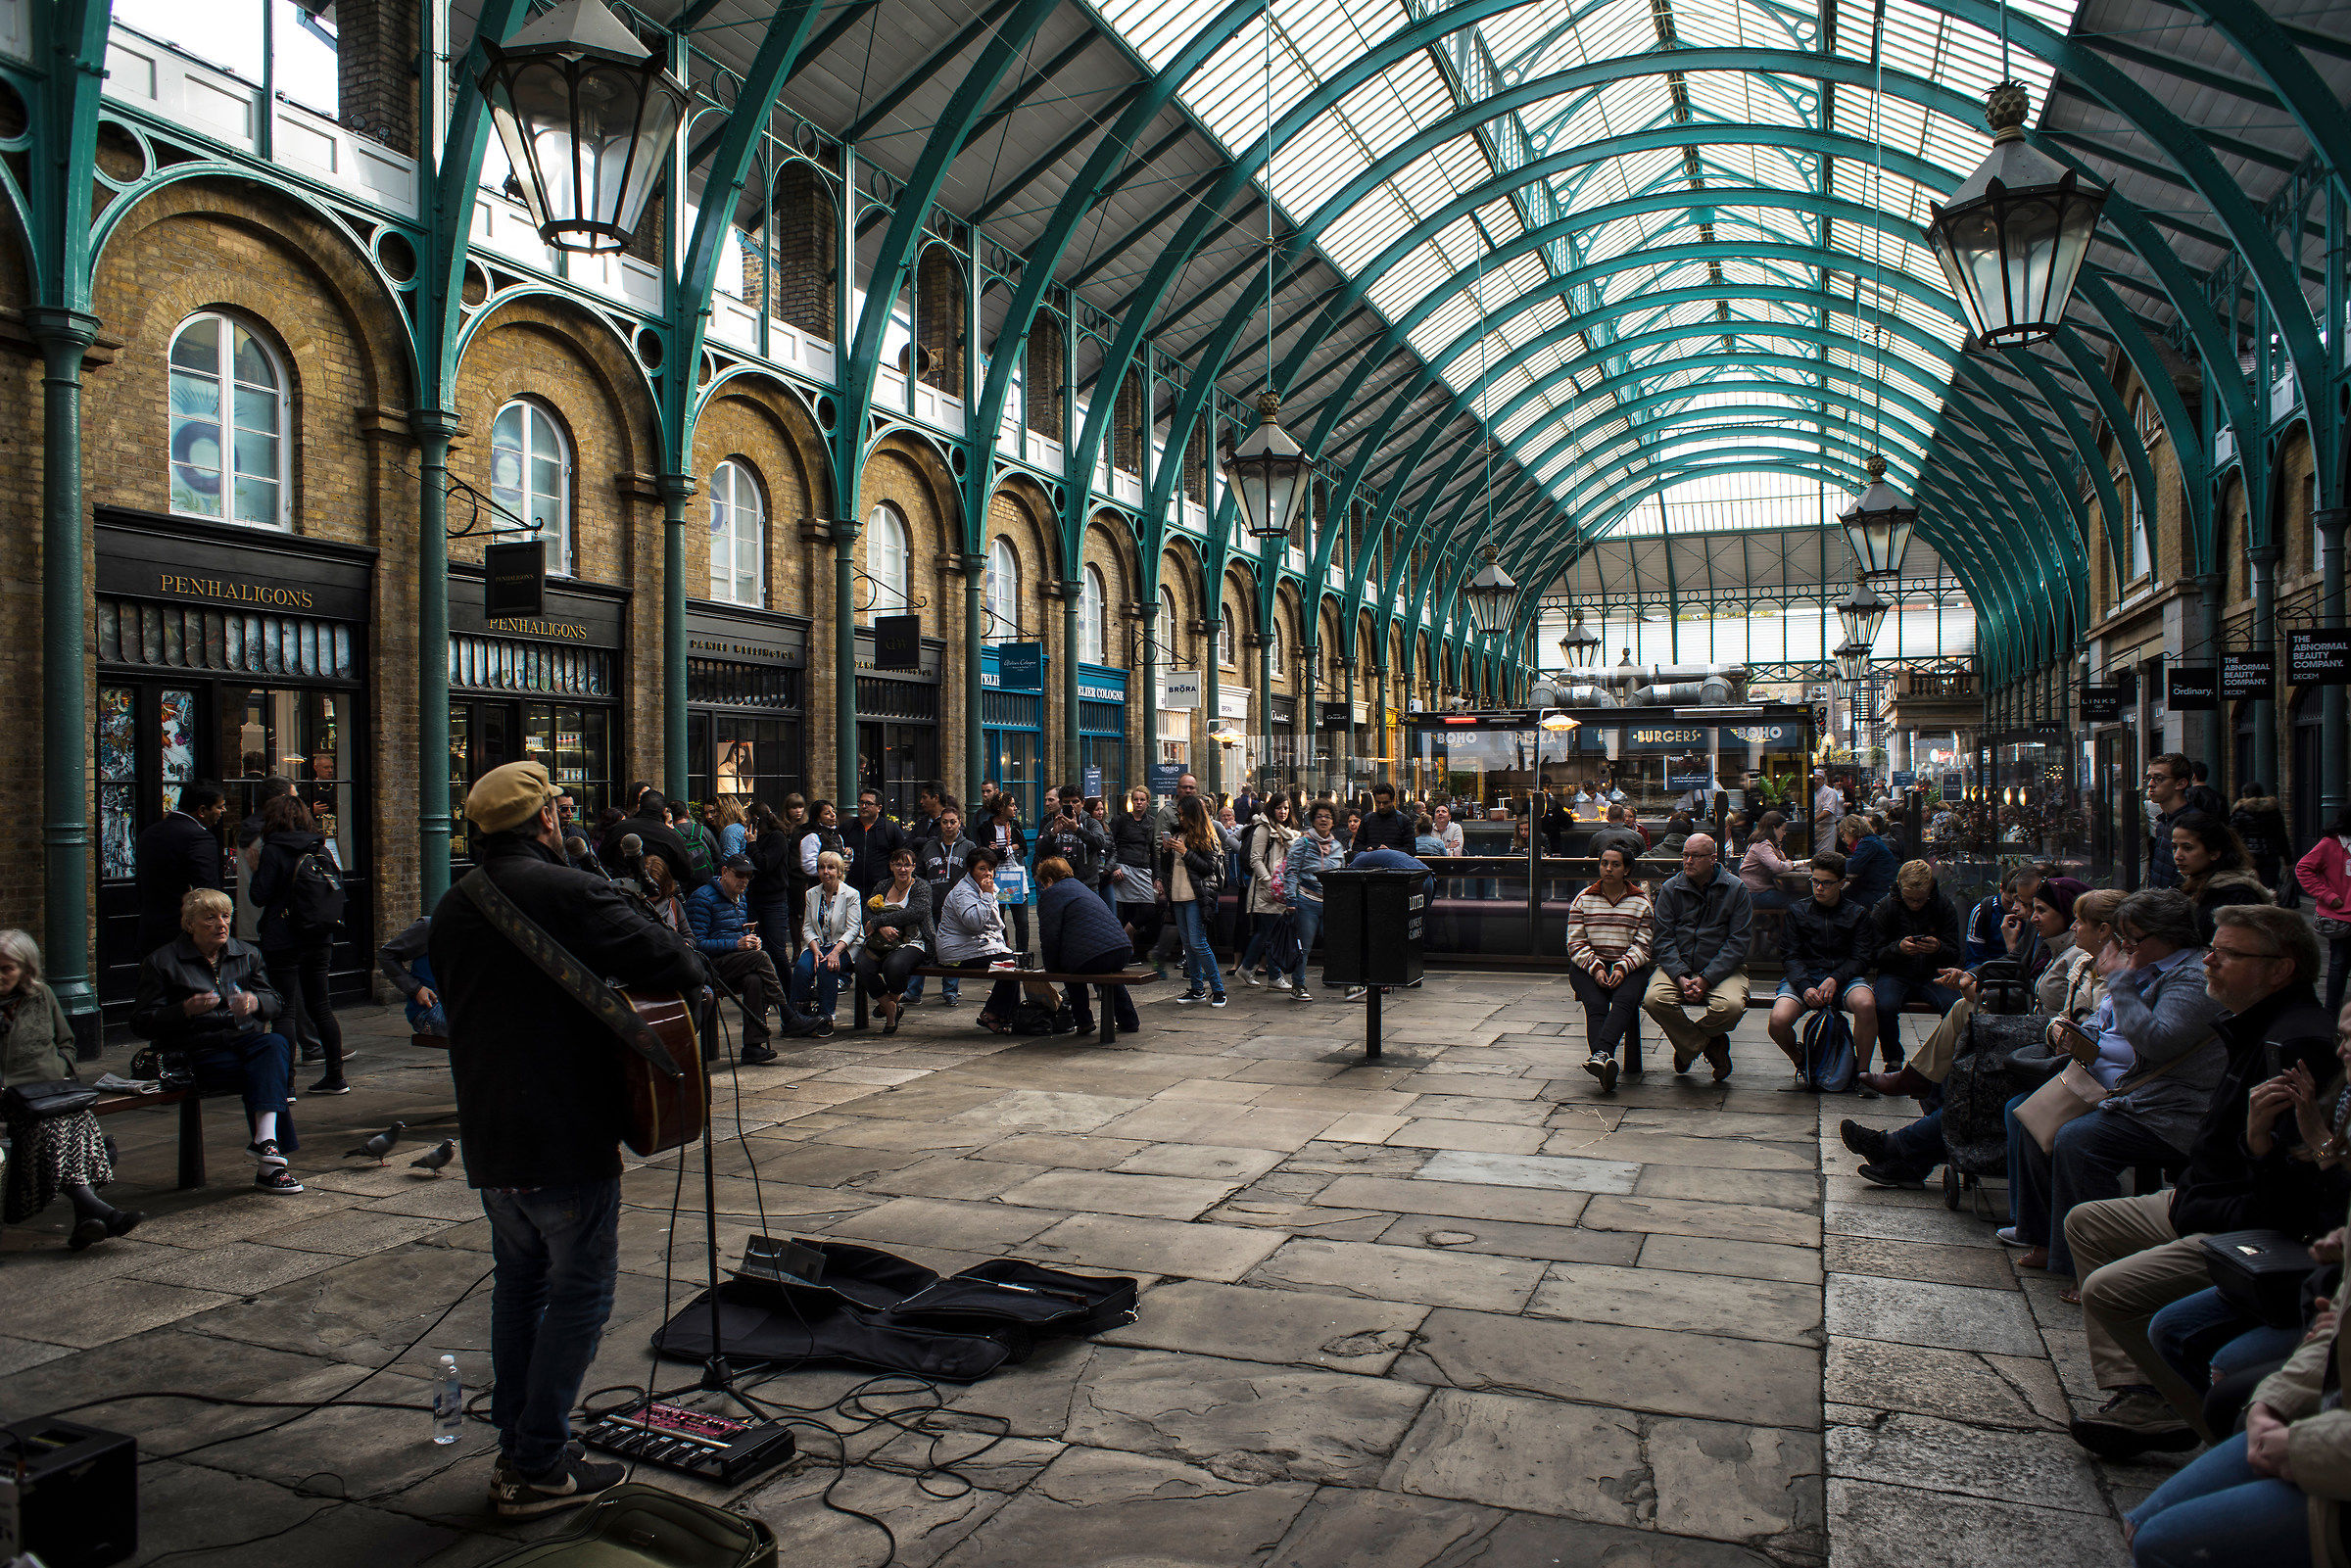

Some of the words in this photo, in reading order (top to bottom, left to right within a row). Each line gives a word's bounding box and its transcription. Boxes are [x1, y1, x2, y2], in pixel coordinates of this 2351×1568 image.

[2293, 635, 2311, 643] THE
[2293, 642, 2348, 651] ABNORMAL
[2293, 651, 2329, 660] BEAUTY
[2224, 663, 2271, 672] ABNORMAL
[2293, 659, 2344, 669] COMPANY.
[2224, 678, 2267, 687] COMPANY.
[1097, 688, 1125, 701] COLOGNE
[2173, 687, 2214, 697] Ordinary.
[1436, 731, 1477, 745] BOHO
[1514, 732, 1558, 744] PIZZA
[1637, 729, 1699, 743] BURGERS
[1737, 726, 1783, 740] BOHO
